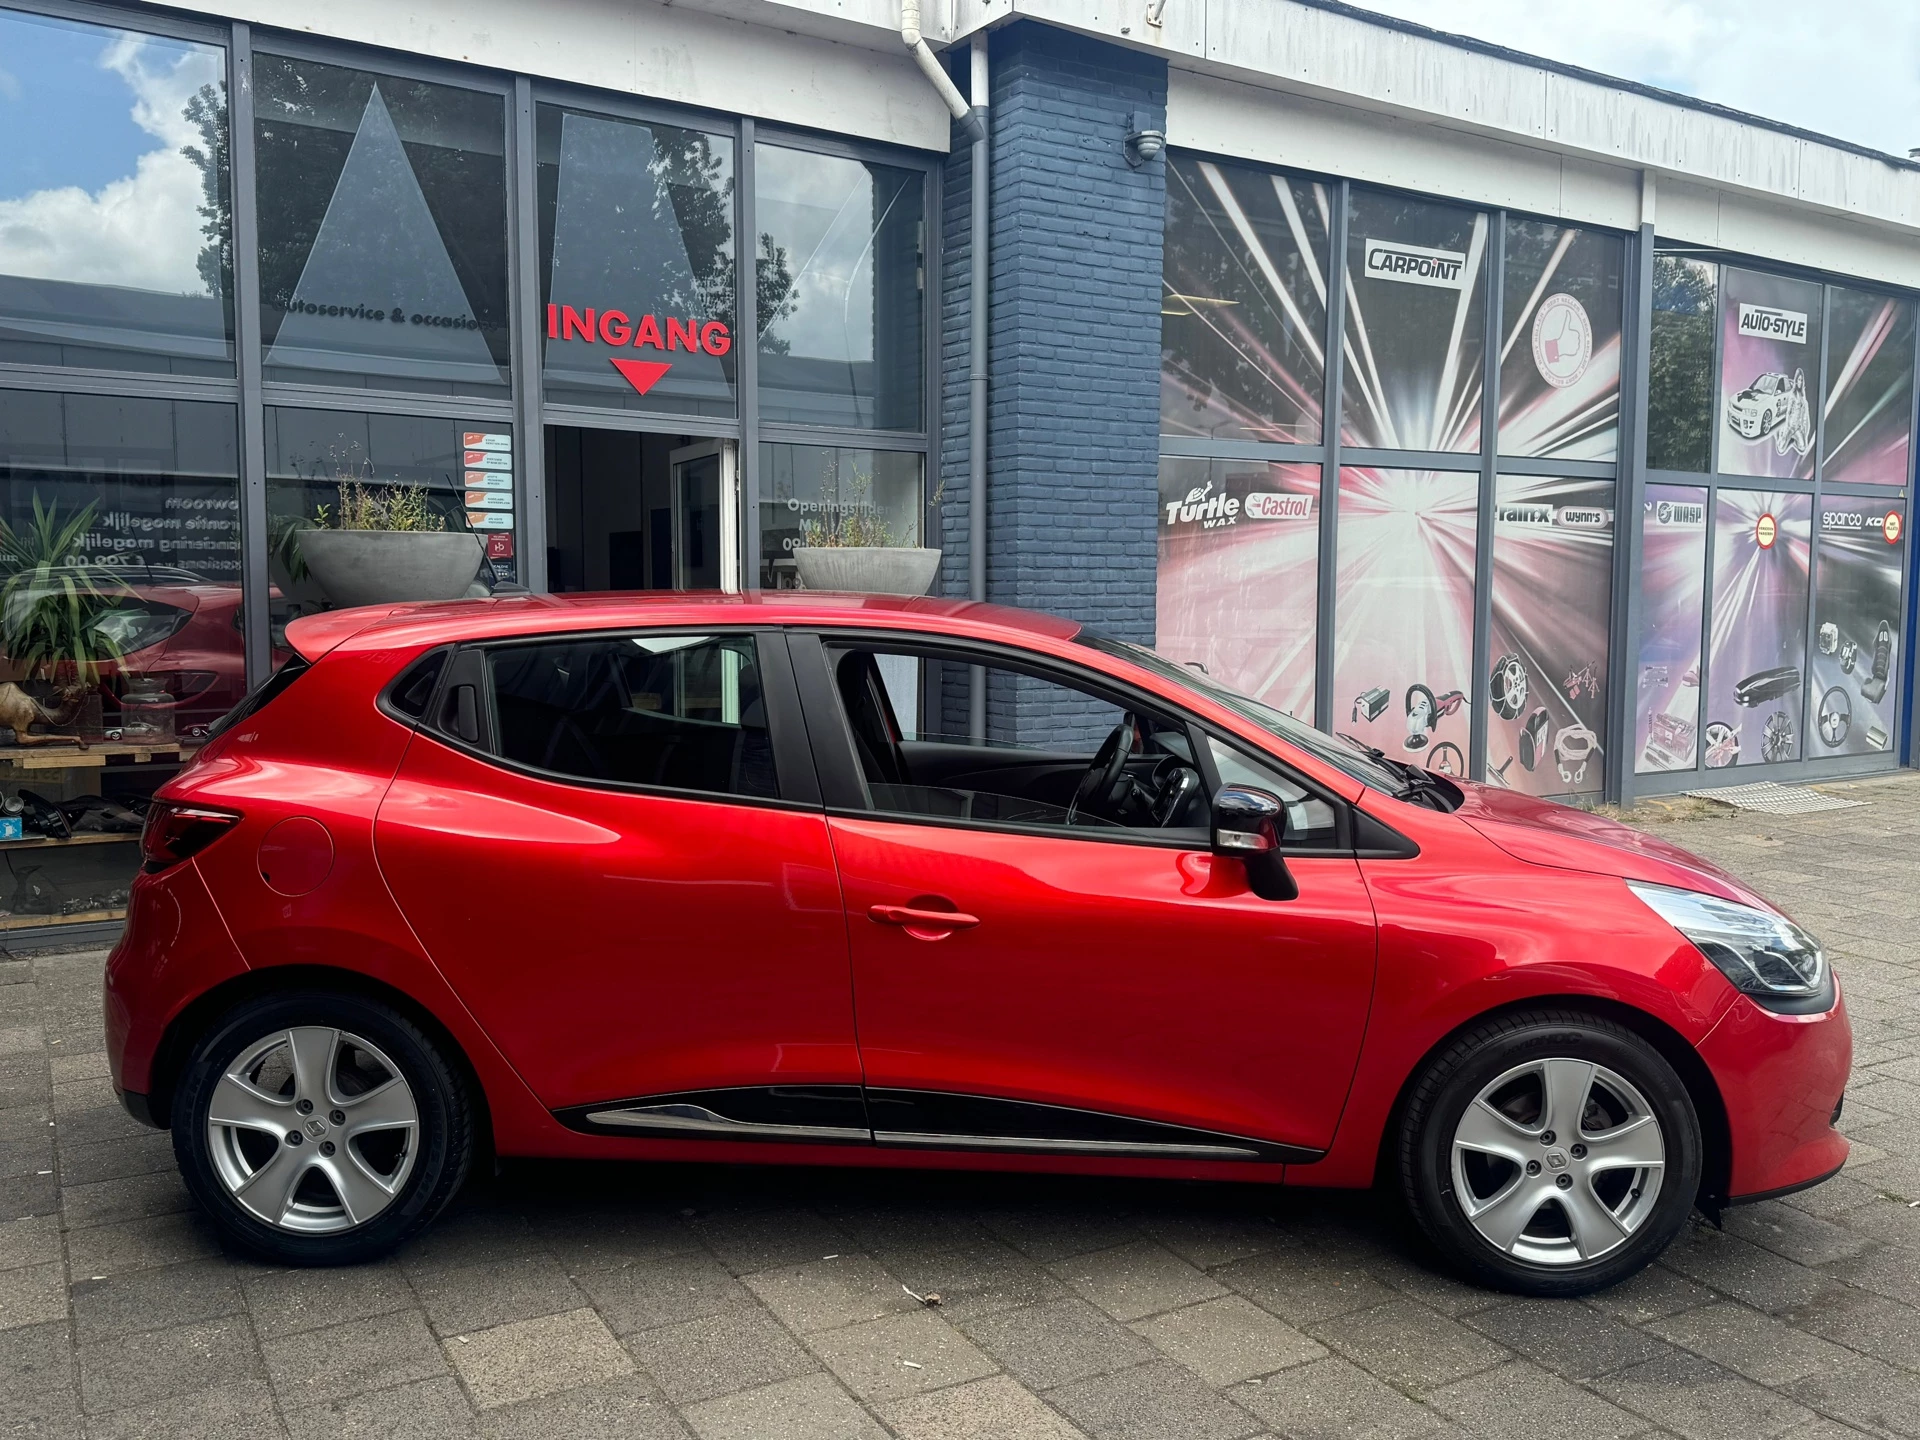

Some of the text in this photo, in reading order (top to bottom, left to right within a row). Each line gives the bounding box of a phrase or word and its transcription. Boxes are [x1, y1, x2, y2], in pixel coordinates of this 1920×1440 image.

[390, 307, 406, 323] &
[1741, 308, 1805, 337] AUTO-STYLE
[547, 303, 731, 357] INGANG
[1166, 492, 1240, 525] Turtle
[1262, 496, 1308, 516] Castrol
[1673, 505, 1702, 523] WASP
[1203, 516, 1237, 529] WAX
[1822, 511, 1862, 530] sparco
[1865, 516, 1884, 526] KO
